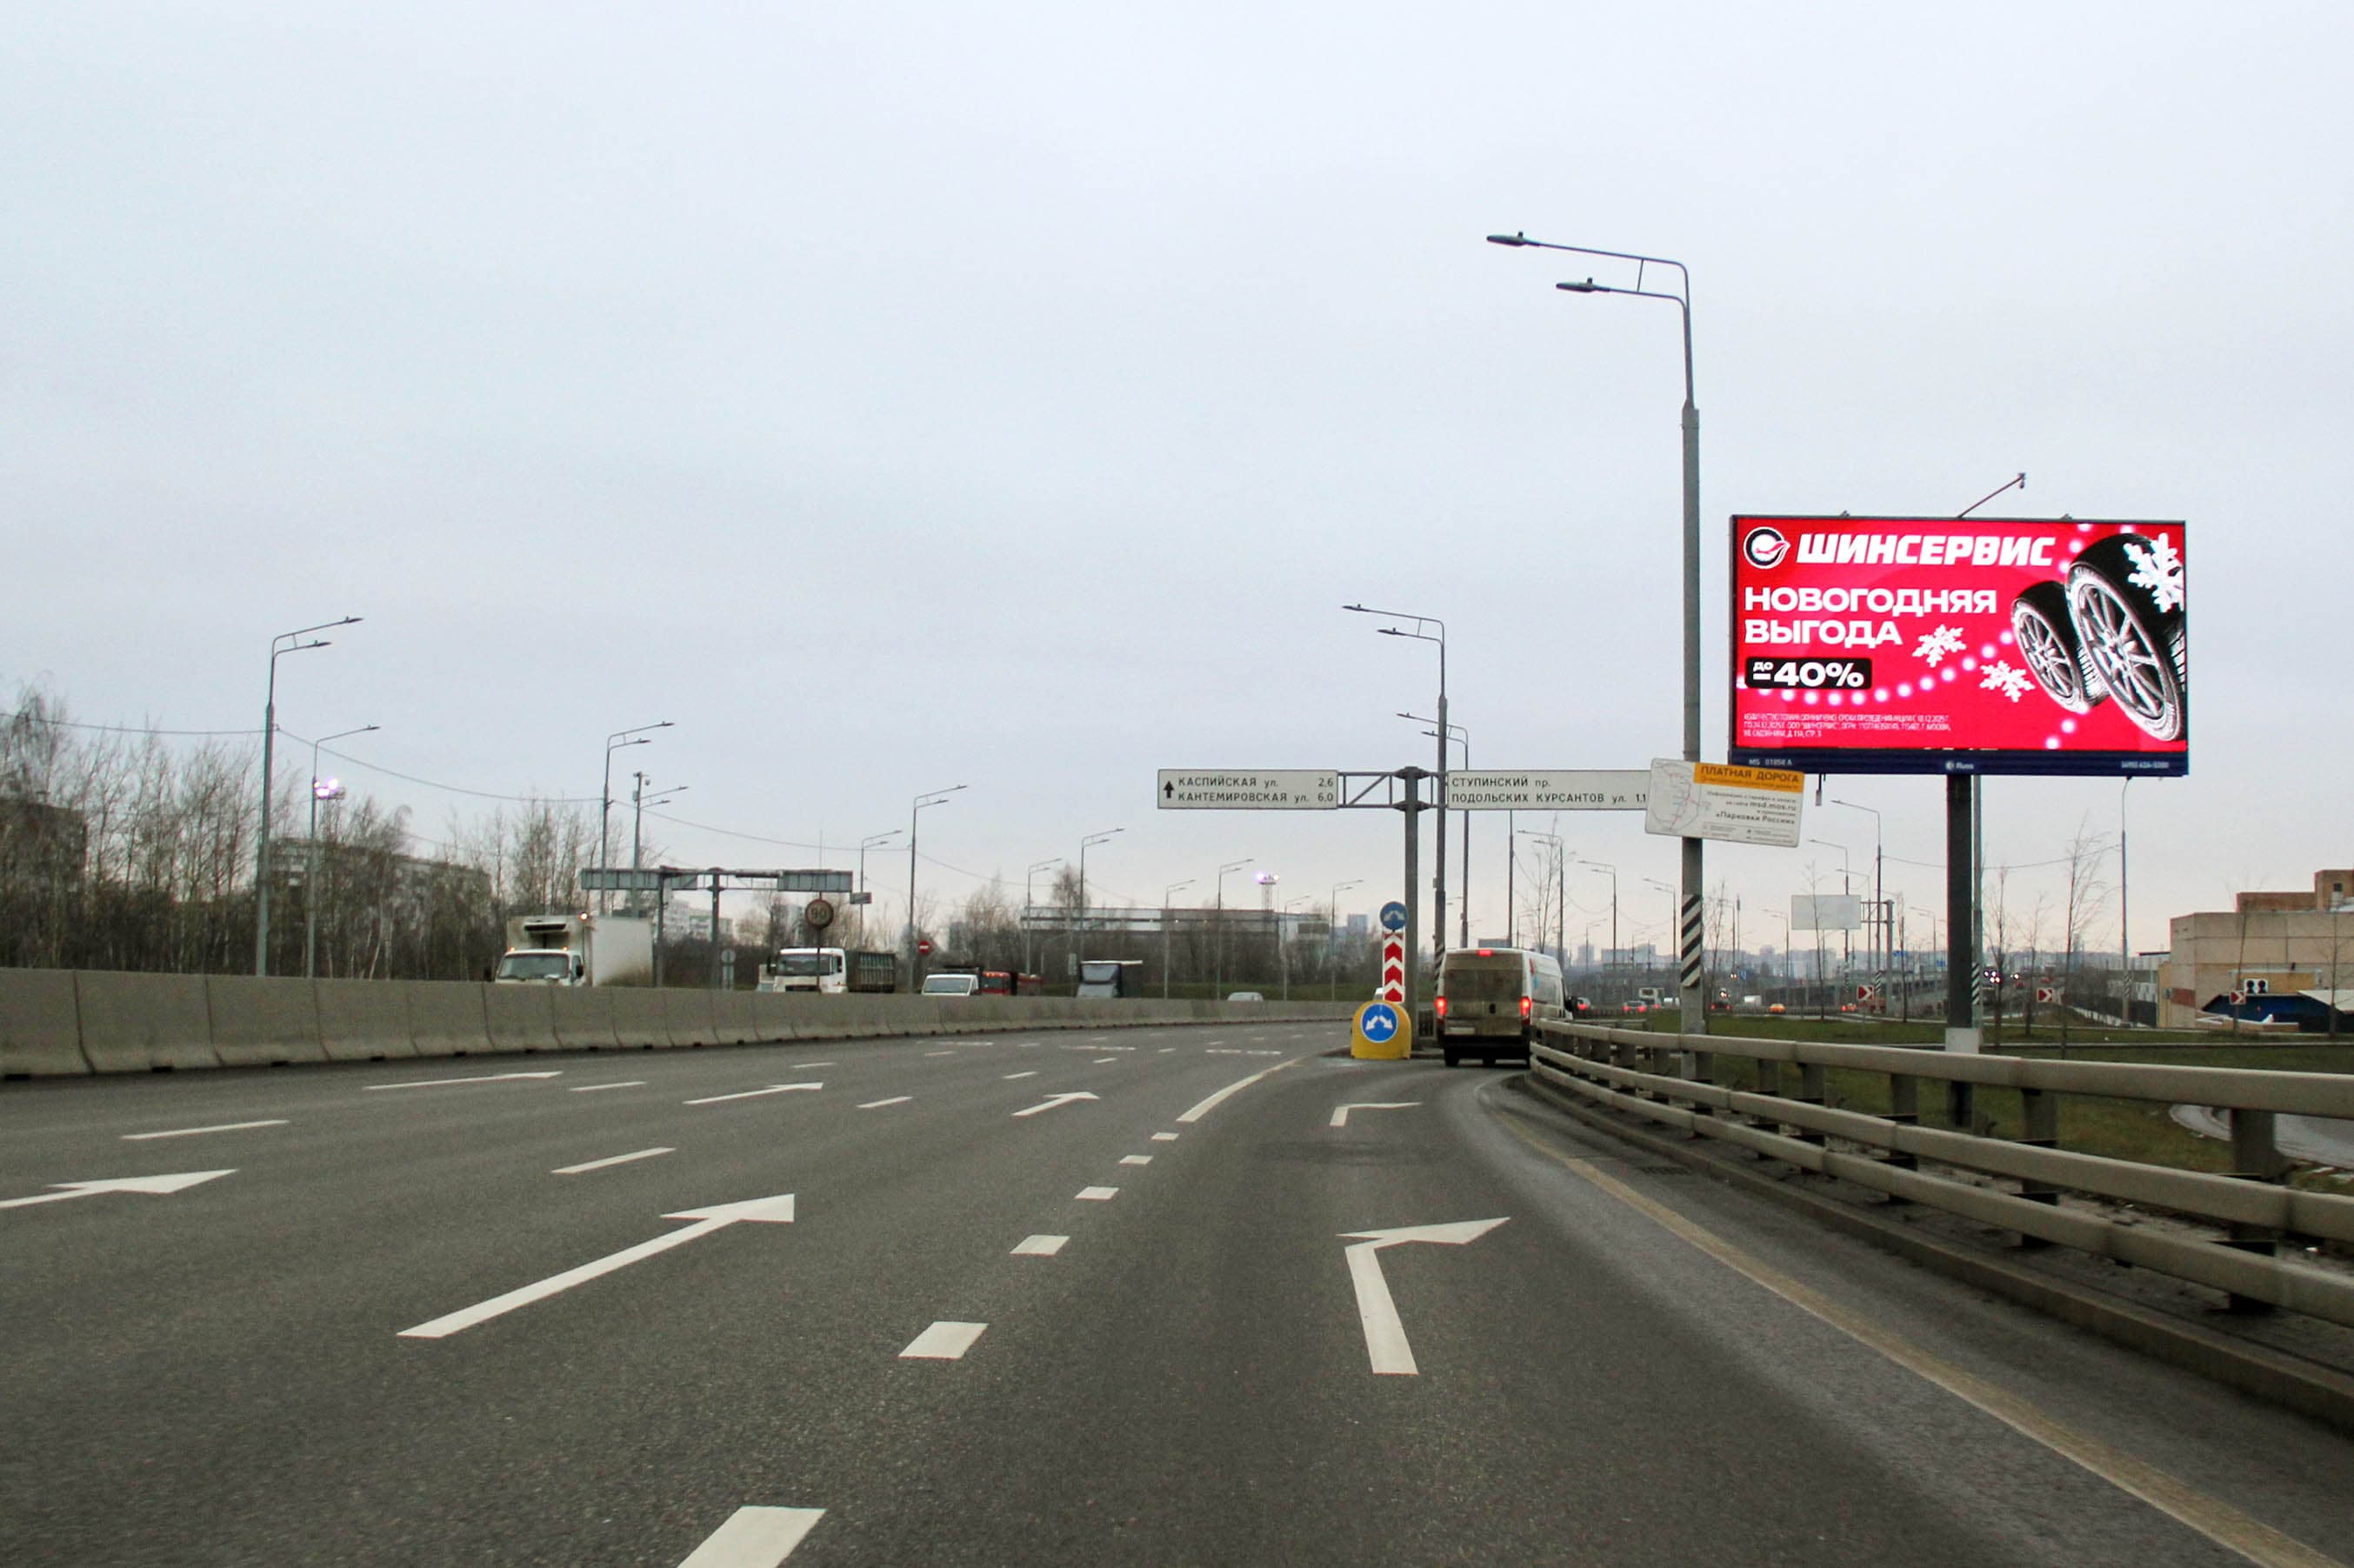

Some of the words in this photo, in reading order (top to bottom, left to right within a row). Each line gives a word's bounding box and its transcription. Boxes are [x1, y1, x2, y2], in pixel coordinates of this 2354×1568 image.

[1797, 533, 2056, 566] ШИНСЕРВИС
[1745, 587, 1997, 617] НОВОГОДНЯЯ
[1744, 619, 1903, 649] ВЫГОДА
[1701, 765, 1752, 778] ПЛАТНАЯ
[1757, 771, 1799, 782] ДОРОГА
[1178, 776, 1257, 787] КАСПИЙСКАЯ
[1264, 778, 1278, 789] ул.
[1451, 776, 1529, 787] СТУПИНСКИЙ
[1535, 779, 1550, 789] пр.
[1178, 792, 1287, 802] КАНТЕМИРОВСКАЯ
[1294, 794, 1309, 804] ул.
[1451, 793, 1529, 804] ПОДОЛЬСКИХ
[1537, 793, 1604, 803] КУРСАНТОВ
[1612, 795, 1627, 804] ул.
